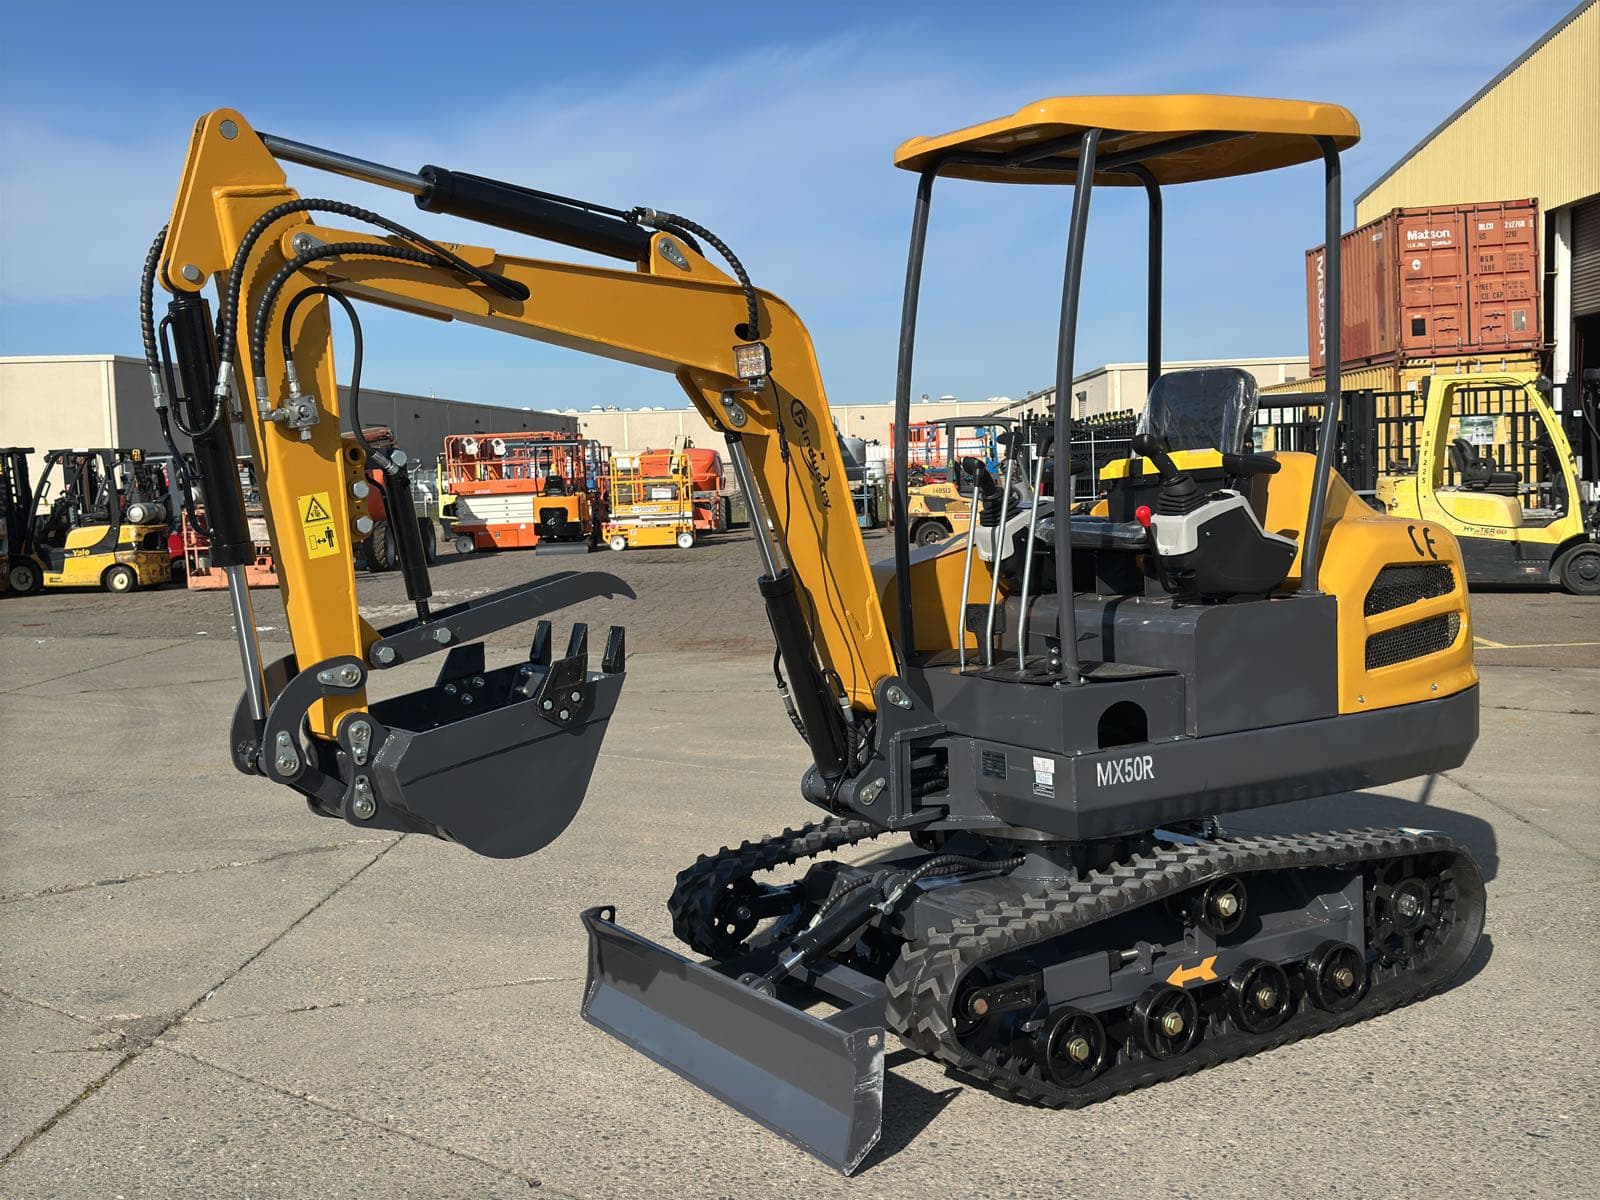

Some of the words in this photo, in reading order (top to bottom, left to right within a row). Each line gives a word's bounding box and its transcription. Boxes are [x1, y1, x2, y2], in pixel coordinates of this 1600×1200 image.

[1407, 230, 1450, 240] Matson
[72, 548, 90, 557] Yale
[1407, 524, 1438, 560] CE
[1096, 755, 1155, 787] MX50R
